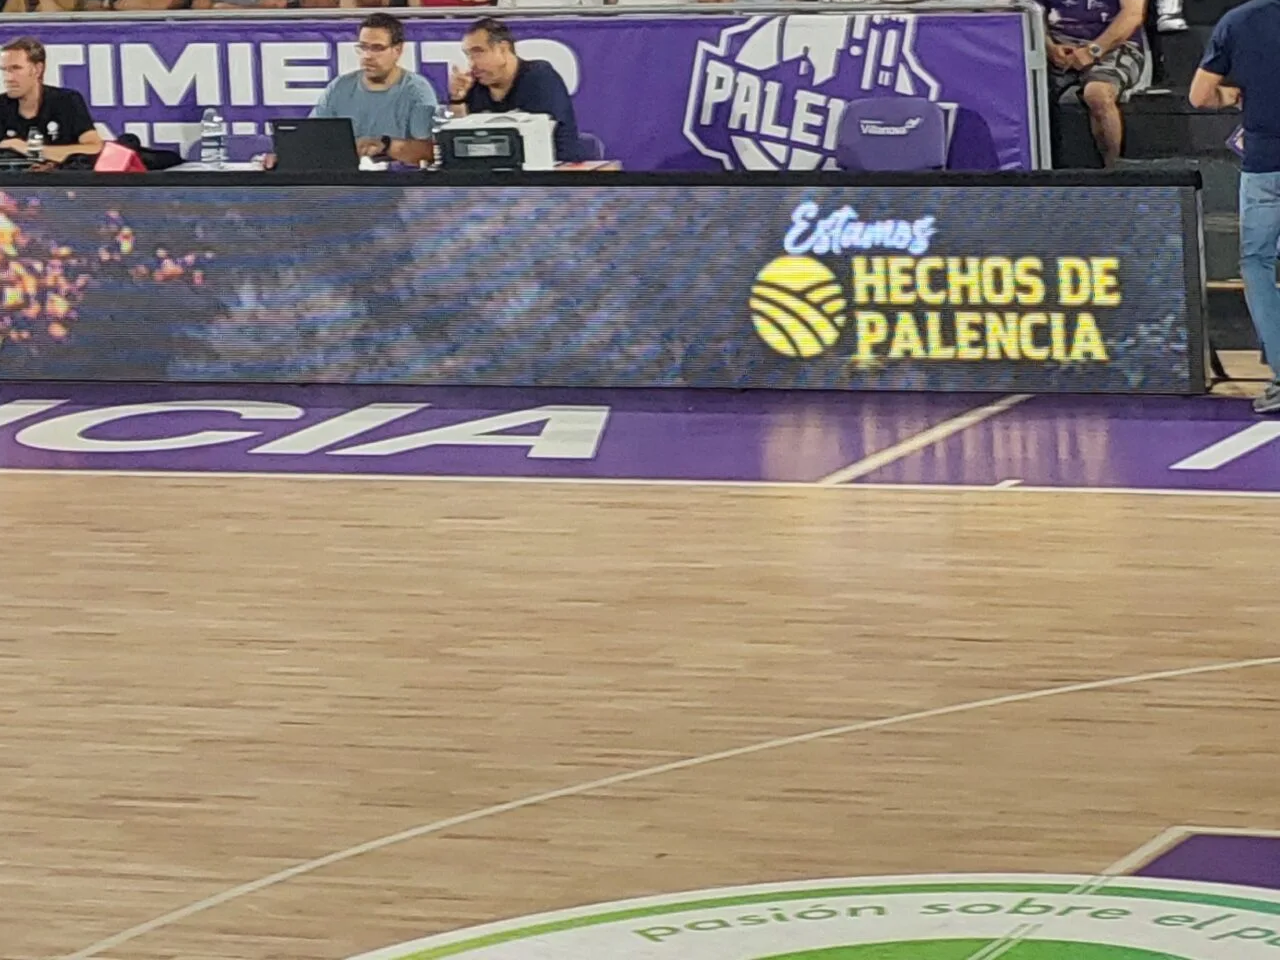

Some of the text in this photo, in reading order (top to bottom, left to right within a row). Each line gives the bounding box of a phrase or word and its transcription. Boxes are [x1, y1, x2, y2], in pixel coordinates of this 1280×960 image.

[784, 201, 937, 255] Estamos
[851, 255, 1122, 307] HECHOS DE
[854, 311, 1110, 362] PALENCIA
[632, 898, 1280, 948] pasión sobre el p
